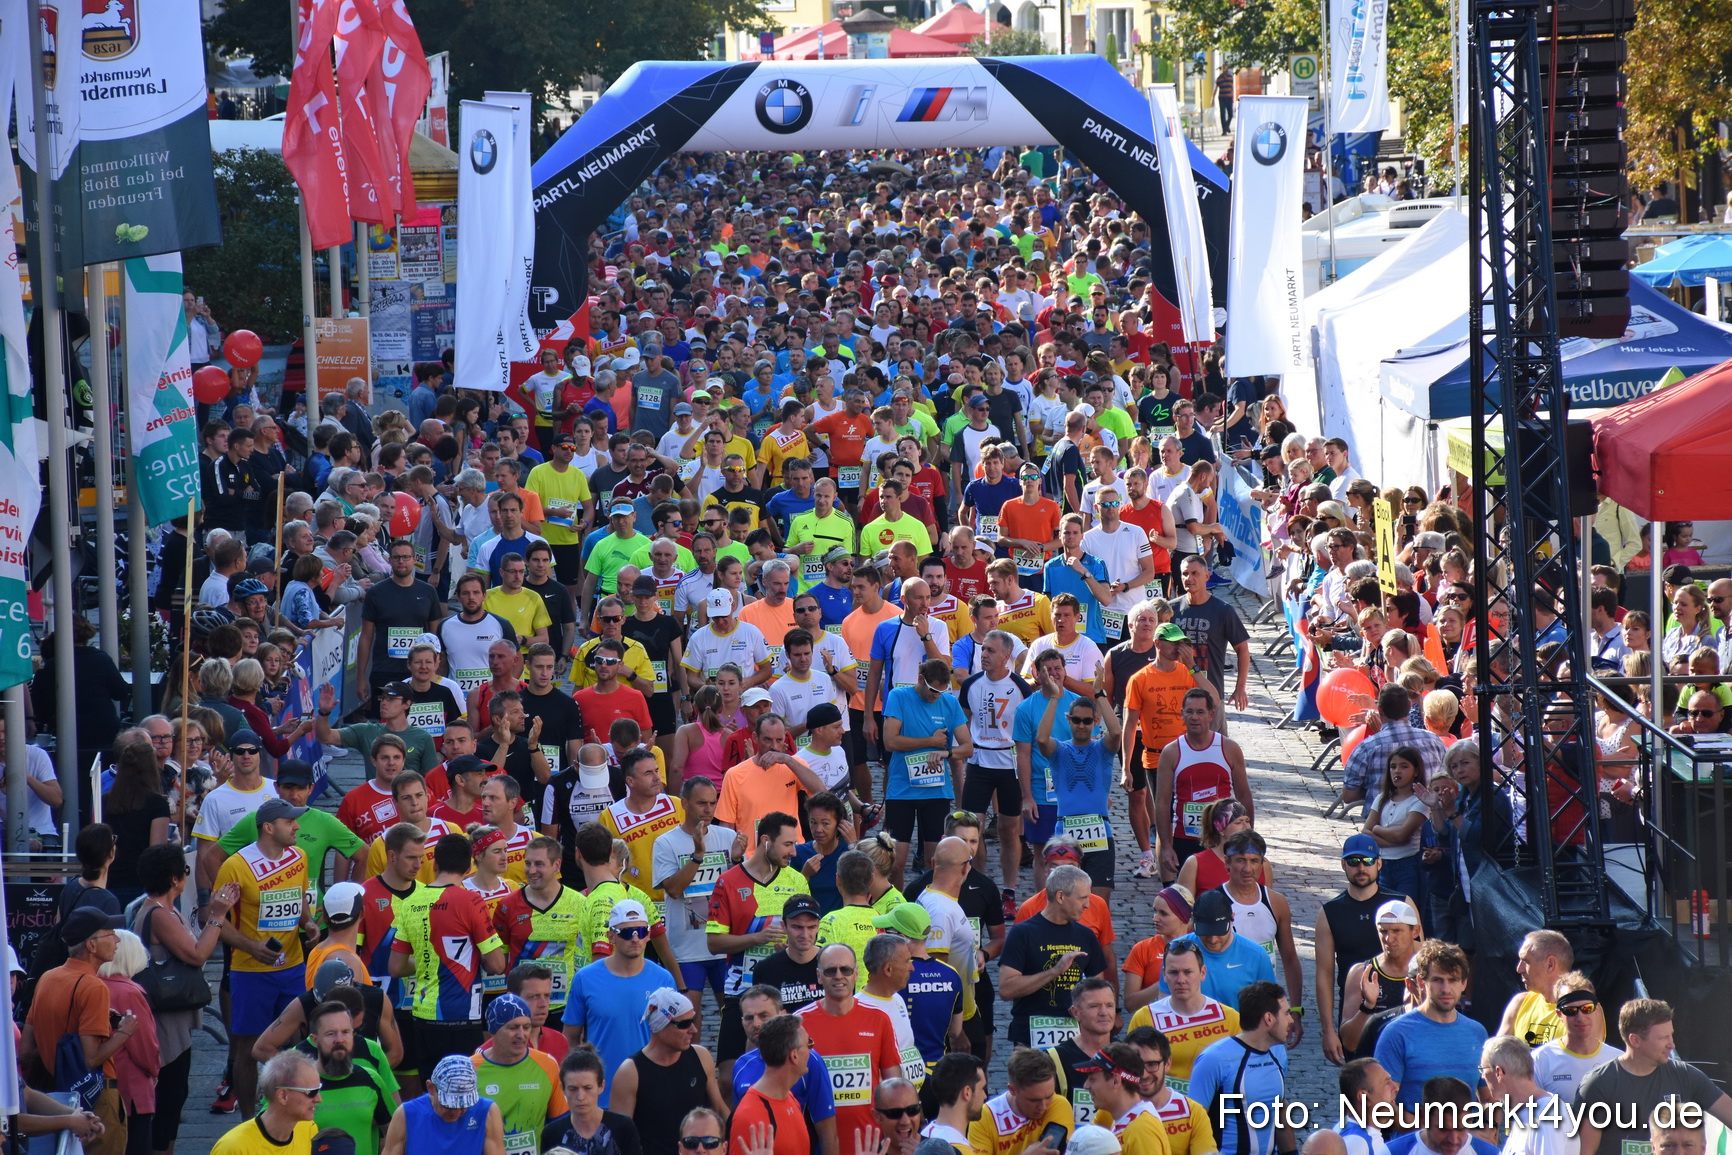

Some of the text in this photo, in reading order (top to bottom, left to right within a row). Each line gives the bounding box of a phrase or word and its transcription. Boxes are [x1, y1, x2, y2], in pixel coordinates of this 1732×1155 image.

[1300, 62, 1310, 74] H
[761, 79, 807, 96] BMW
[1082, 117, 1128, 155] PARTL
[534, 124, 657, 212] PARTL NEUMARKT
[1285, 267, 1303, 368] PARTL NEUMARKT
[518, 318, 533, 353] PARTL
[640, 394, 659, 403] 2128
[841, 473, 860, 481] 2301
[1376, 503, 1391, 522] Block
[1381, 530, 1392, 574] A
[806, 564, 826, 573] 209
[1016, 558, 1040, 568] 2724
[1012, 610, 1036, 621] BÖGL
[1175, 617, 1211, 631] MUD
[391, 627, 420, 636] BOCK
[393, 638, 415, 648] 267
[410, 703, 441, 713] BOCK
[411, 715, 441, 726] 2664
[918, 776, 941, 784] STEFAN
[1066, 818, 1099, 826] BOCK
[623, 817, 681, 844] MAX BÖGL
[1069, 827, 1101, 840] 1211
[259, 877, 284, 891] MAX
[265, 891, 298, 902] BOCK
[265, 903, 299, 918] 2390
[410, 902, 449, 913] Team Partl
[268, 919, 296, 927] ROBERT
[854, 923, 874, 931] Team
[929, 930, 943, 940] 20
[422, 918, 430, 981] Mtorport
[452, 938, 468, 960] 7
[1047, 944, 1081, 952] Neumarkter
[781, 985, 809, 995] SWIM.
[908, 982, 953, 993] BOCK
[1035, 1018, 1073, 1027] BOCK
[1193, 1025, 1229, 1040] BÖGL
[906, 1063, 924, 1080] 1209
